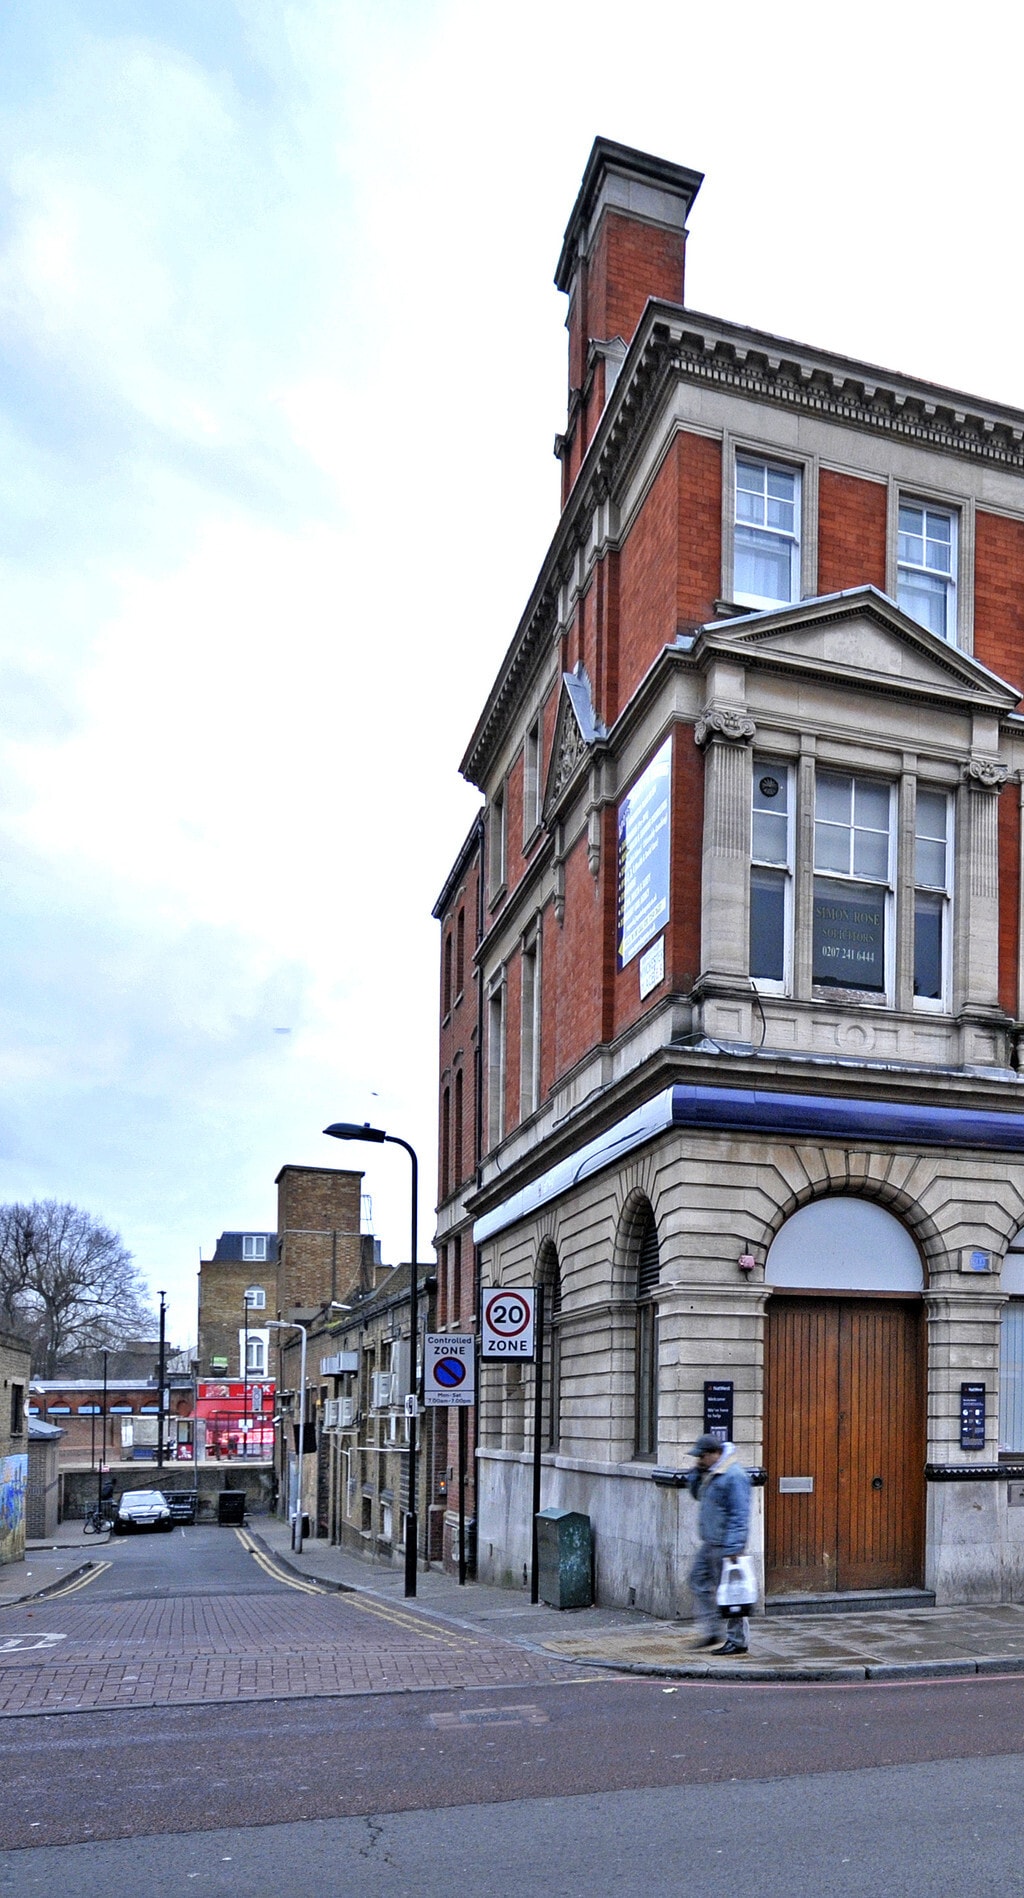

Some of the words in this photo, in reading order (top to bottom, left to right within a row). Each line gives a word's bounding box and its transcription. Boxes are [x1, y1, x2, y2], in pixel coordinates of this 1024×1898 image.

[817, 906, 848, 920] SIMON
[854, 911, 880, 925] ROSE
[822, 928, 874, 942] SOLICITORS
[822, 946, 840, 957] 0207
[842, 948, 854, 960] 241
[857, 950, 875, 962] 6444
[493, 1305, 523, 1324] 20
[427, 1336, 472, 1344] Controlled
[488, 1340, 528, 1351] ZONE
[434, 1346, 466, 1355] ZONE
